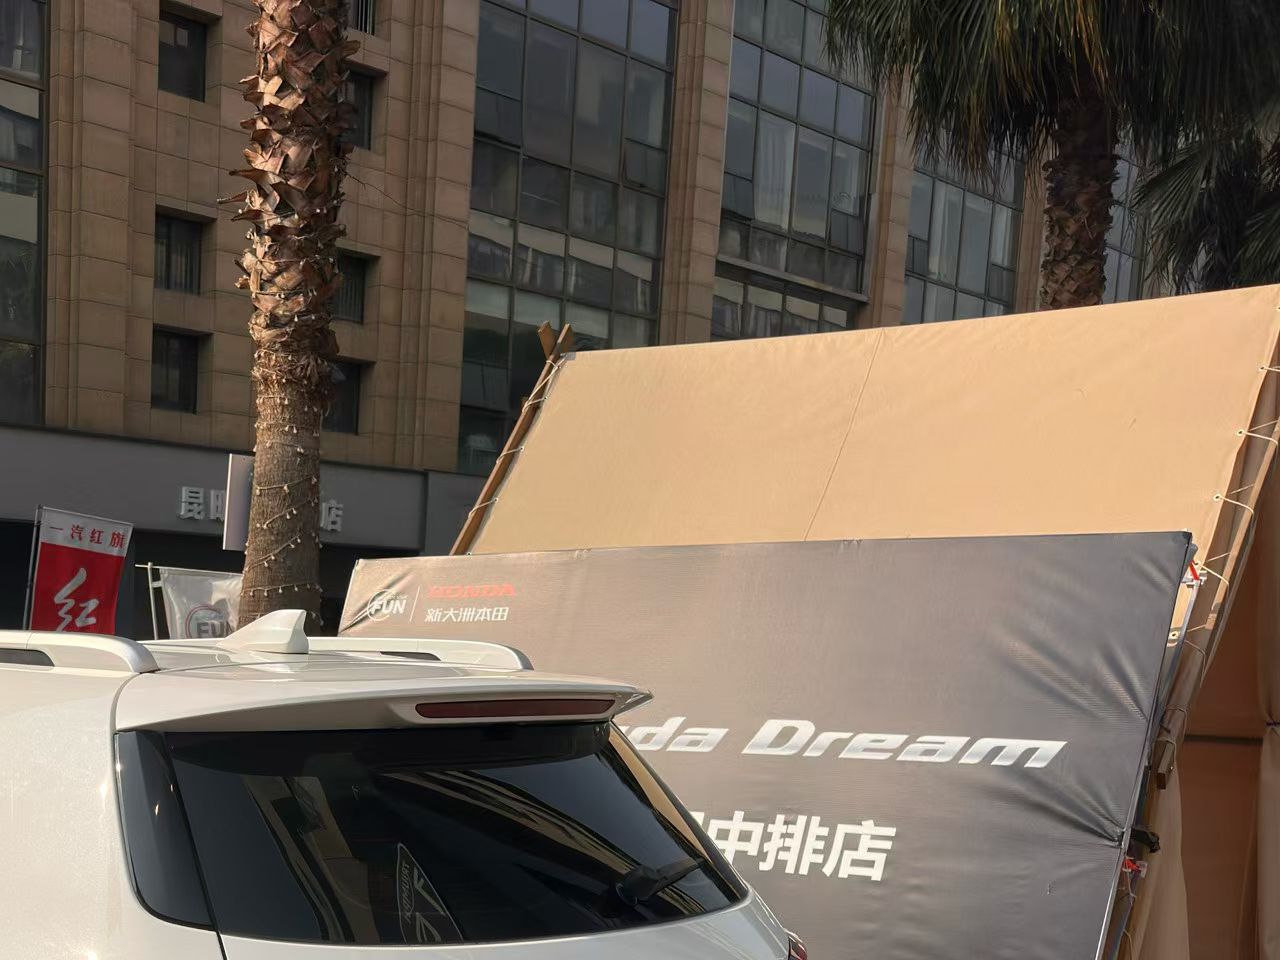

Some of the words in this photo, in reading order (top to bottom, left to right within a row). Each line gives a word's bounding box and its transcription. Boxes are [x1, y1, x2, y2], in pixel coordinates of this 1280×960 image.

[49, 523, 126, 549] 一汽红旗
[370, 598, 407, 615] FUN
[424, 607, 509, 623] 新大洲本田
[619, 716, 729, 753] da
[740, 719, 1068, 769] Dream
[689, 810, 897, 881] 中排店
